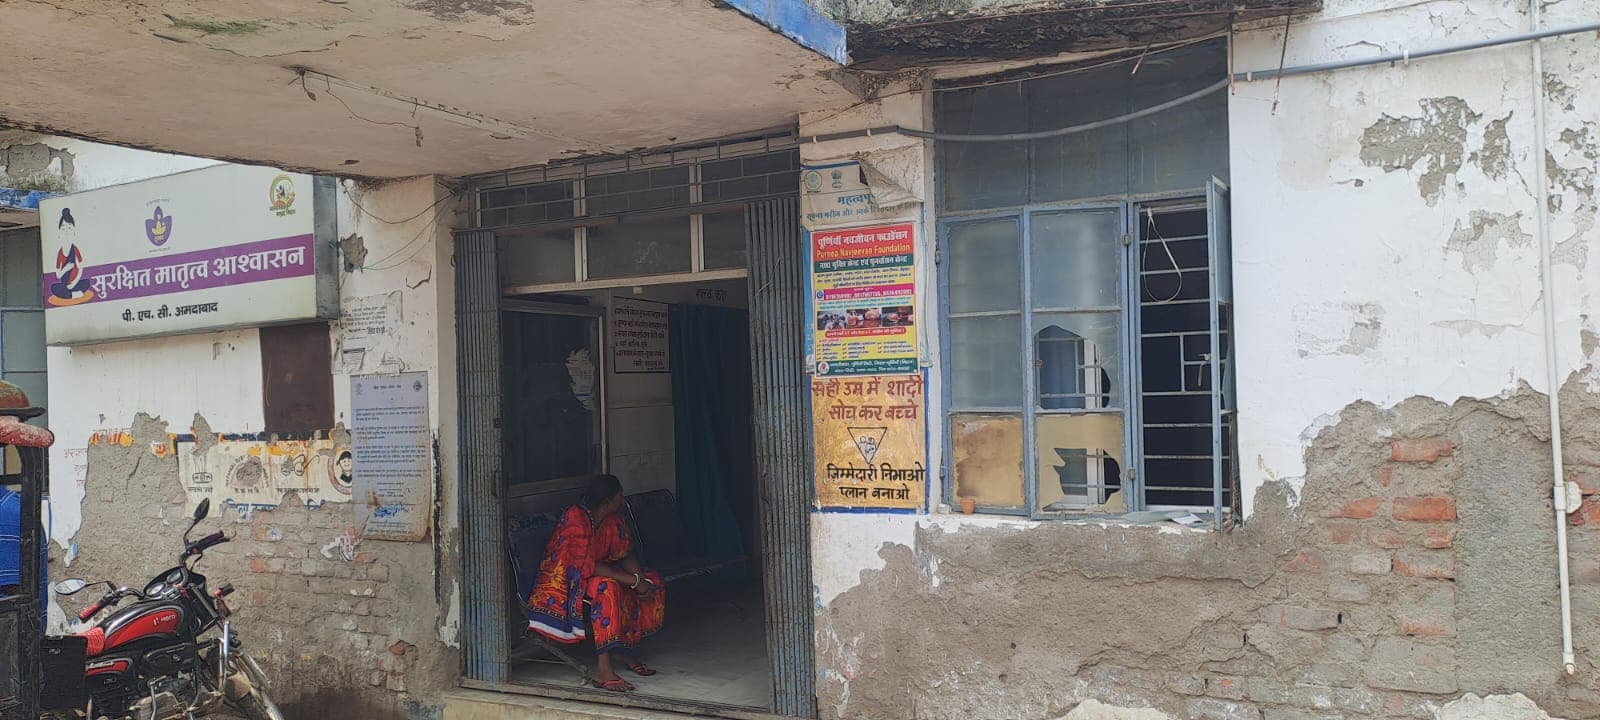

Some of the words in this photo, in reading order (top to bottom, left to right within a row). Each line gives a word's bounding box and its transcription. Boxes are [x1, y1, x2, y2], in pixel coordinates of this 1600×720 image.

[837, 193, 875, 206] महत्वपू
[816, 249, 839, 259] Purnea
[840, 246, 873, 258] Navjeevan
[874, 243, 910, 254] Foundation
[91, 264, 151, 298] सुरक्षित
[154, 260, 209, 288] मातृत्व
[213, 246, 306, 276] आश्वासन
[122, 308, 135, 322] पी.
[137, 309, 154, 321] एच.
[157, 304, 172, 318] सी.
[174, 302, 218, 316] अमदाबाद
[813, 378, 839, 397] सही
[867, 376, 880, 396] में
[887, 375, 924, 398] शादी
[829, 399, 856, 420] सोच
[858, 406, 882, 420] कर
[885, 399, 918, 420] बच्चे
[880, 461, 925, 482] निभाओ
[839, 486, 868, 499] प्लान
[872, 483, 910, 500] बनाओ
